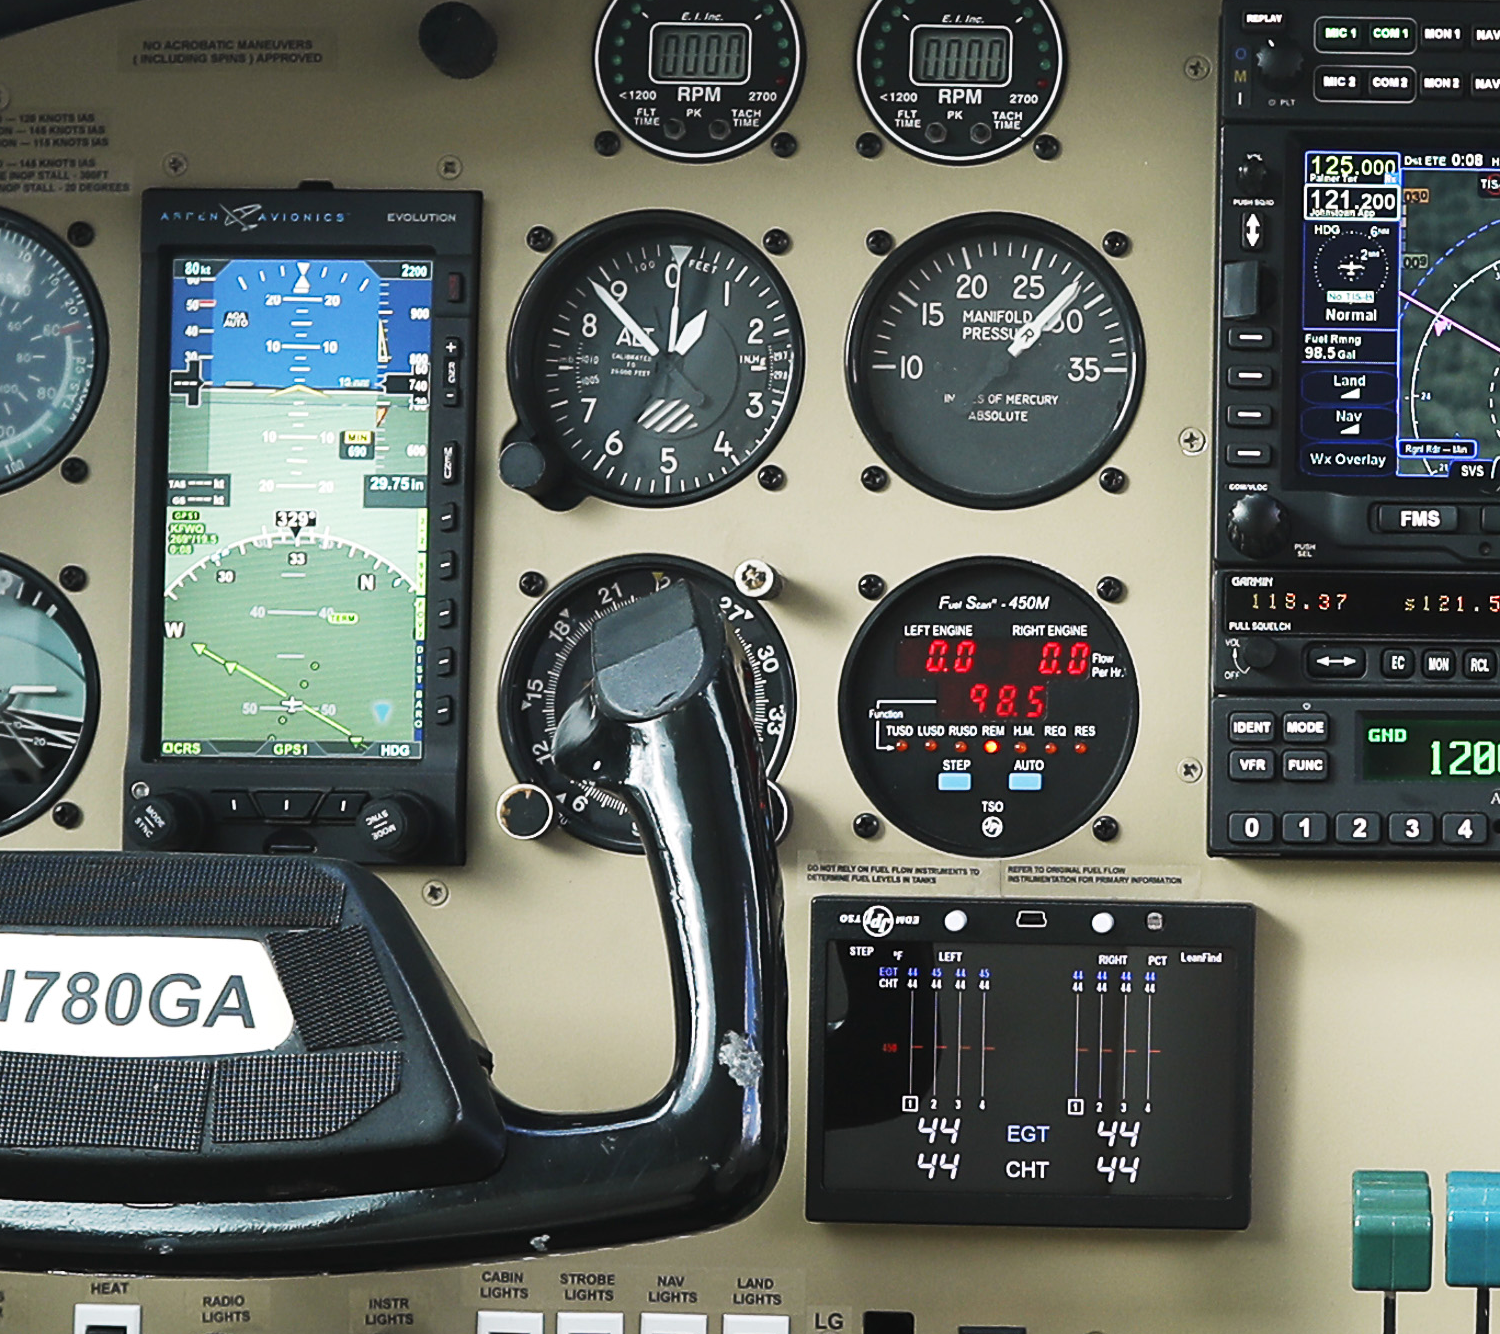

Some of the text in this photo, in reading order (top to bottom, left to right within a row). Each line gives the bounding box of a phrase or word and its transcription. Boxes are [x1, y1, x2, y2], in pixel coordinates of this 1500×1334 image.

[678, 88, 720, 103] RPM
[749, 92, 777, 101] 2700
[939, 90, 1038, 105] RPM 2700
[957, 275, 1044, 298] 20 25
[921, 304, 944, 326] 15
[963, 311, 1032, 324] MANIFOLD
[1326, 308, 1377, 321] Normal
[900, 356, 922, 379] 10
[1068, 358, 1099, 382] 35
[1333, 374, 1366, 387] Land
[1310, 453, 1386, 467] Wx Overlay
[1401, 511, 1439, 527] FMS
[1232, 576, 1273, 588] GARMIN
[904, 625, 972, 636] LEFT ENGINE
[1012, 625, 1088, 636] RIGHT ENGINE
[926, 639, 976, 674] 0.0
[1039, 641, 1090, 675] 0.0
[969, 684, 1044, 717] 98.5
[982, 726, 1004, 736] REM
[1234, 721, 1270, 734] IDENT
[1287, 721, 1324, 734] MODE
[1368, 728, 1407, 743] GND
[942, 759, 971, 770] STEP
[1014, 759, 1044, 770] AUTO
[1240, 759, 1266, 770] VFR
[1289, 758, 1323, 771] FUNC
[982, 801, 1003, 812] TSO
[939, 951, 962, 962] LEFT
[1099, 955, 1128, 965] RIGHT
[918, 1118, 1140, 1147] 44 EGT 44
[918, 1154, 1139, 1182] 44 CHT 44
[482, 1272, 523, 1285] CABIN
[559, 1274, 615, 1286] STROBE
[91, 1283, 129, 1295] HEAT
[480, 1287, 529, 1299] LIGHTS
[565, 1289, 613, 1302] LIGHTS
[815, 1312, 843, 1330] LG
